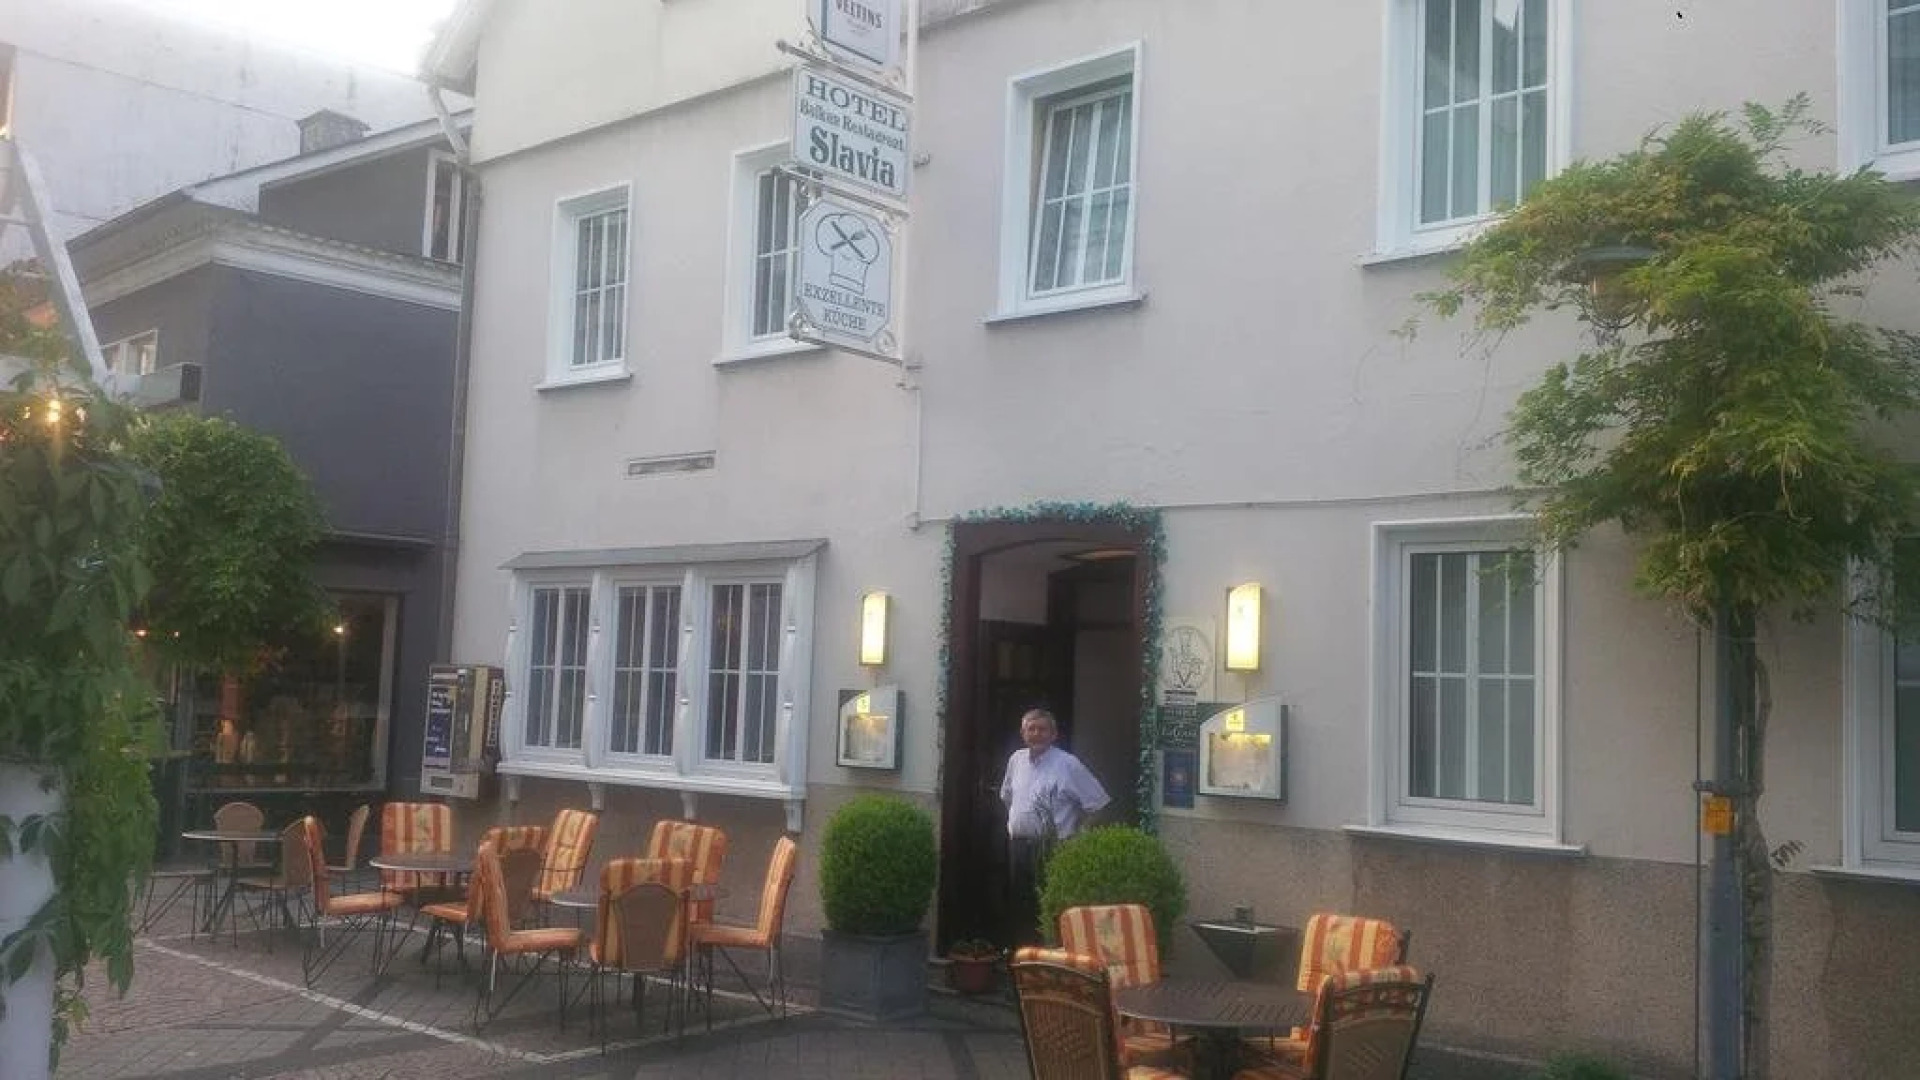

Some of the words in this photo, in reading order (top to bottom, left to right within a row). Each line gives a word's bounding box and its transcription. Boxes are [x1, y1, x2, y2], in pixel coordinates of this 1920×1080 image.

[835, 0, 882, 28] VELTINS
[808, 75, 906, 132] HOTEL
[809, 126, 895, 188] Slavia
[804, 282, 886, 318] EXZELLENTE
[824, 307, 867, 331] KÜCHE
